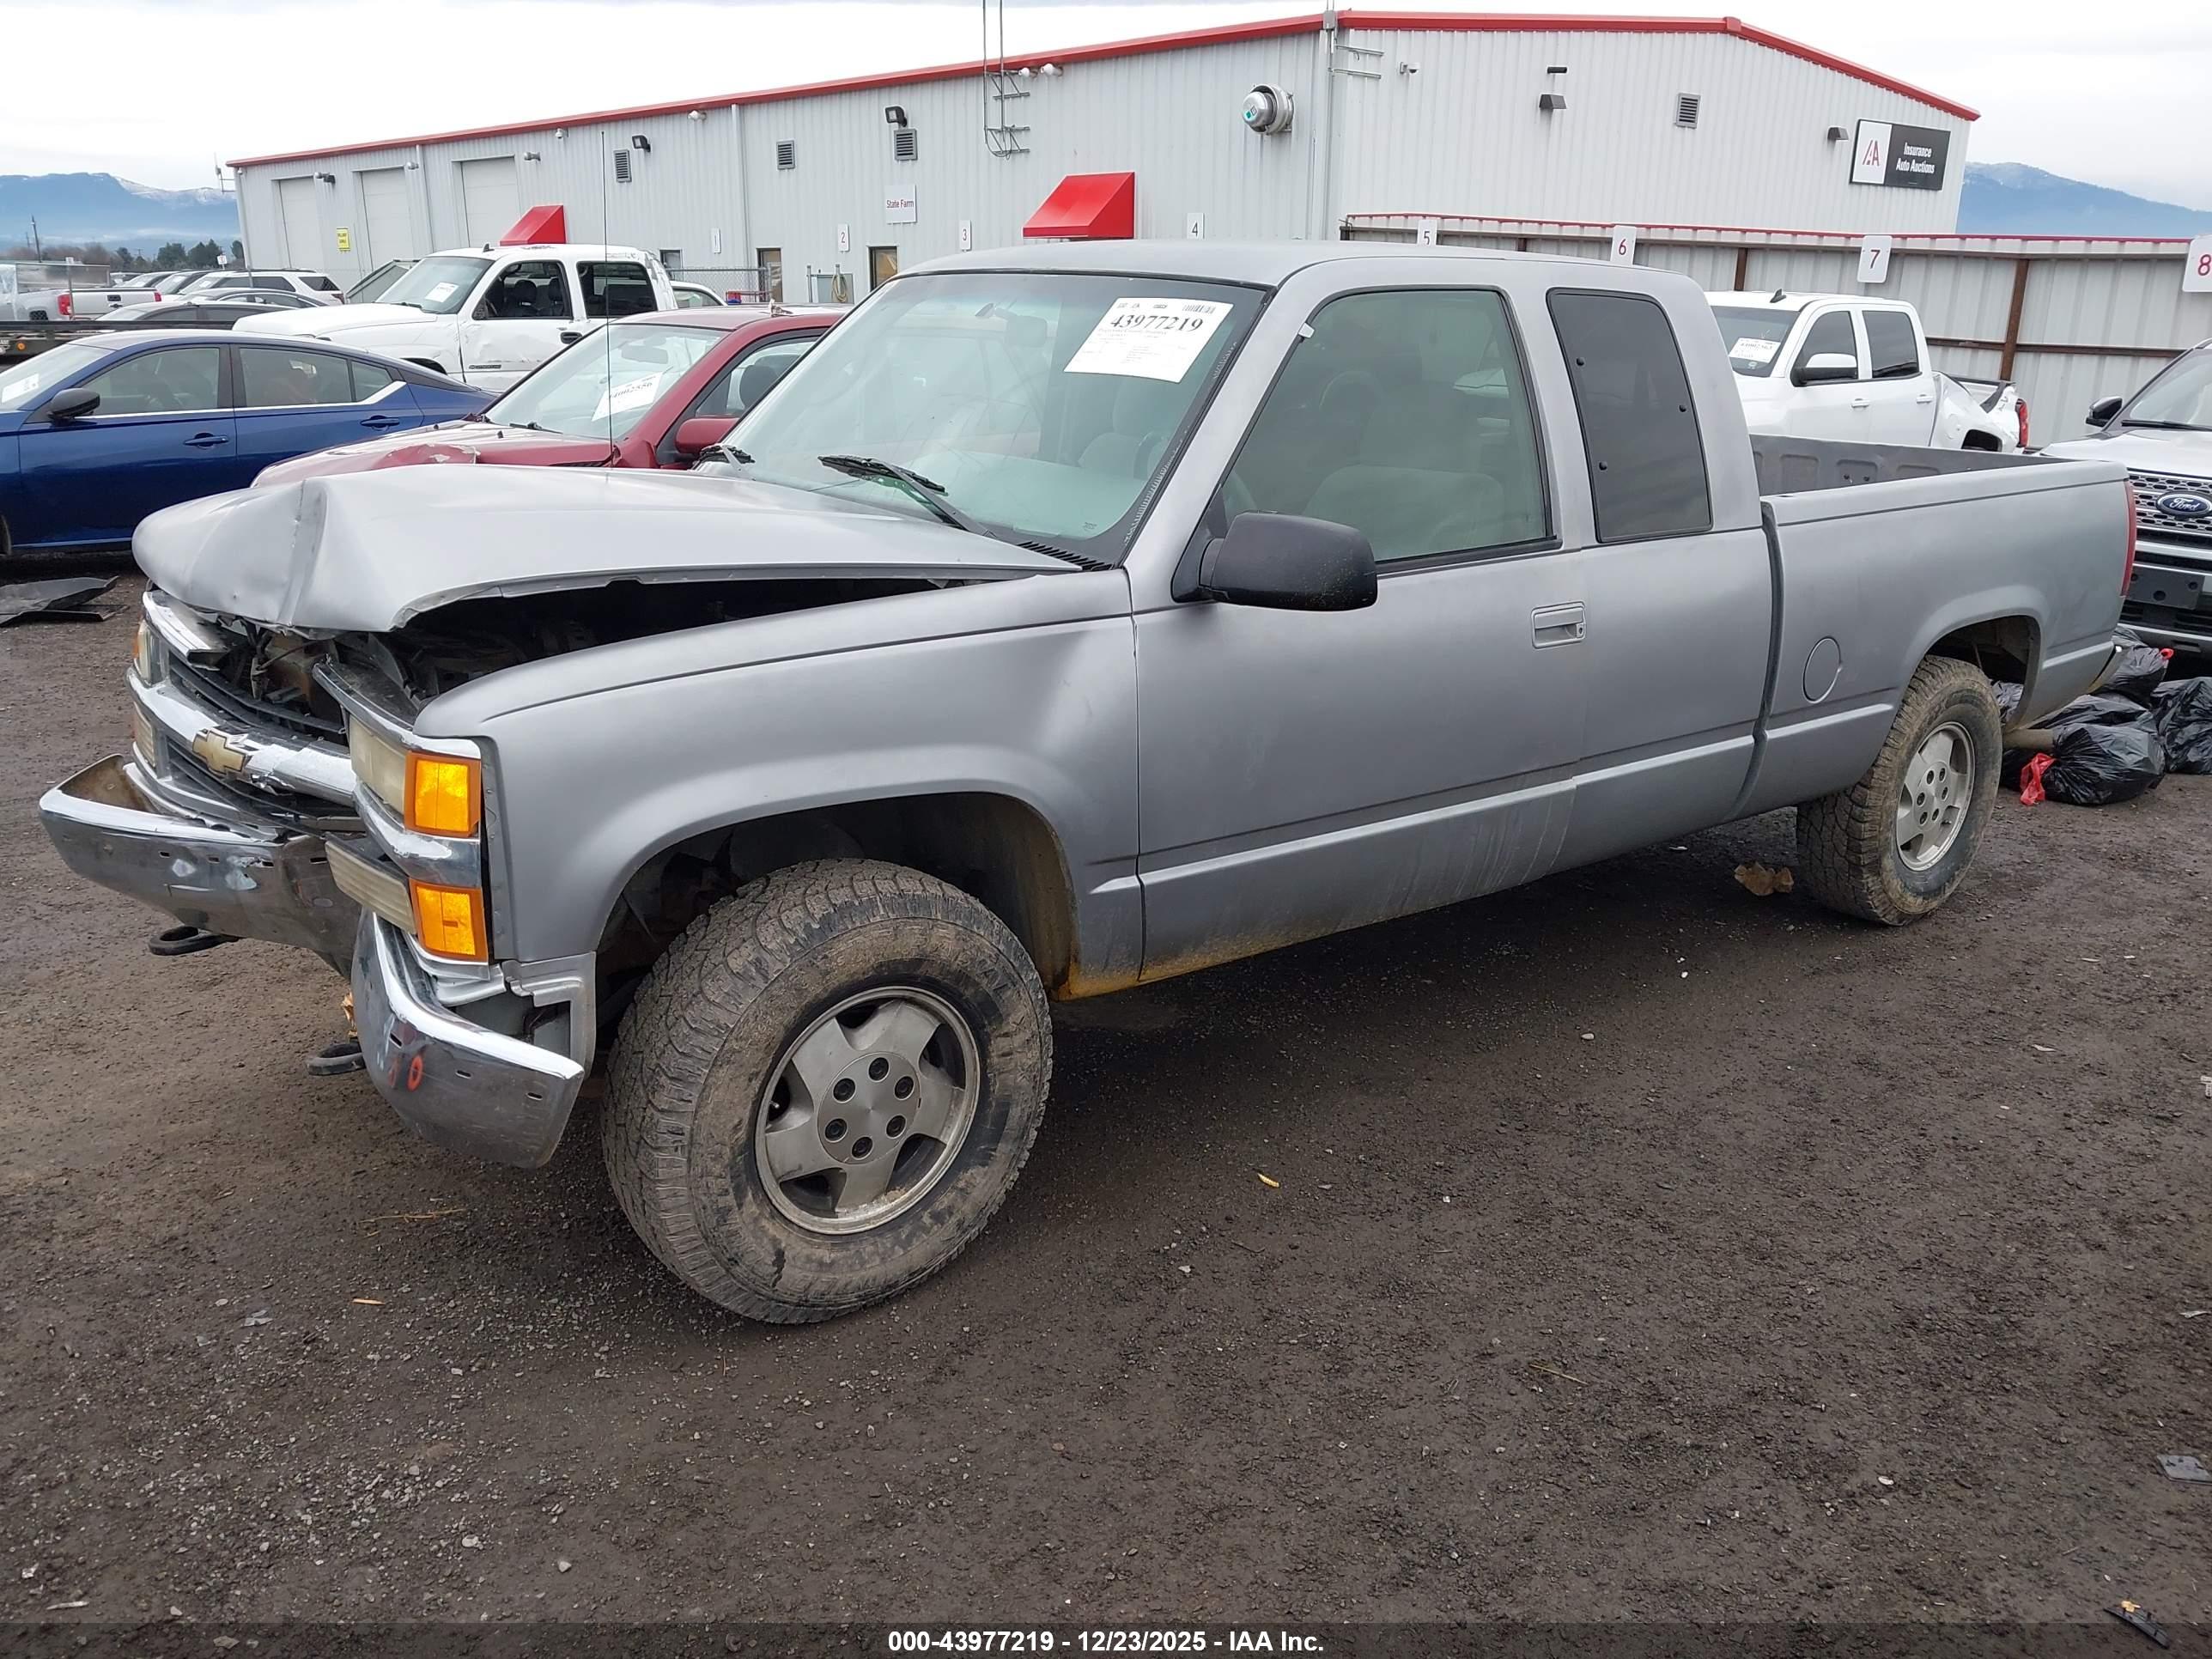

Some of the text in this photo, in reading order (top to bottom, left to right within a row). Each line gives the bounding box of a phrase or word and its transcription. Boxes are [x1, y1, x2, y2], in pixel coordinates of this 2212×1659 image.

[1903, 142, 1932, 158] Insurance
[1895, 158, 1936, 173] Auto Auctions
[886, 199, 915, 209] State Farm
[962, 228, 968, 241] 3
[1191, 222, 1199, 237] 4
[841, 232, 846, 244] 2
[1423, 230, 1431, 246] 5
[1619, 238, 1627, 255] 6
[1869, 249, 1881, 269] 7
[2197, 253, 2212, 276] 8
[1110, 314, 1204, 332] 43977219
[2169, 498, 2201, 512] Ford
